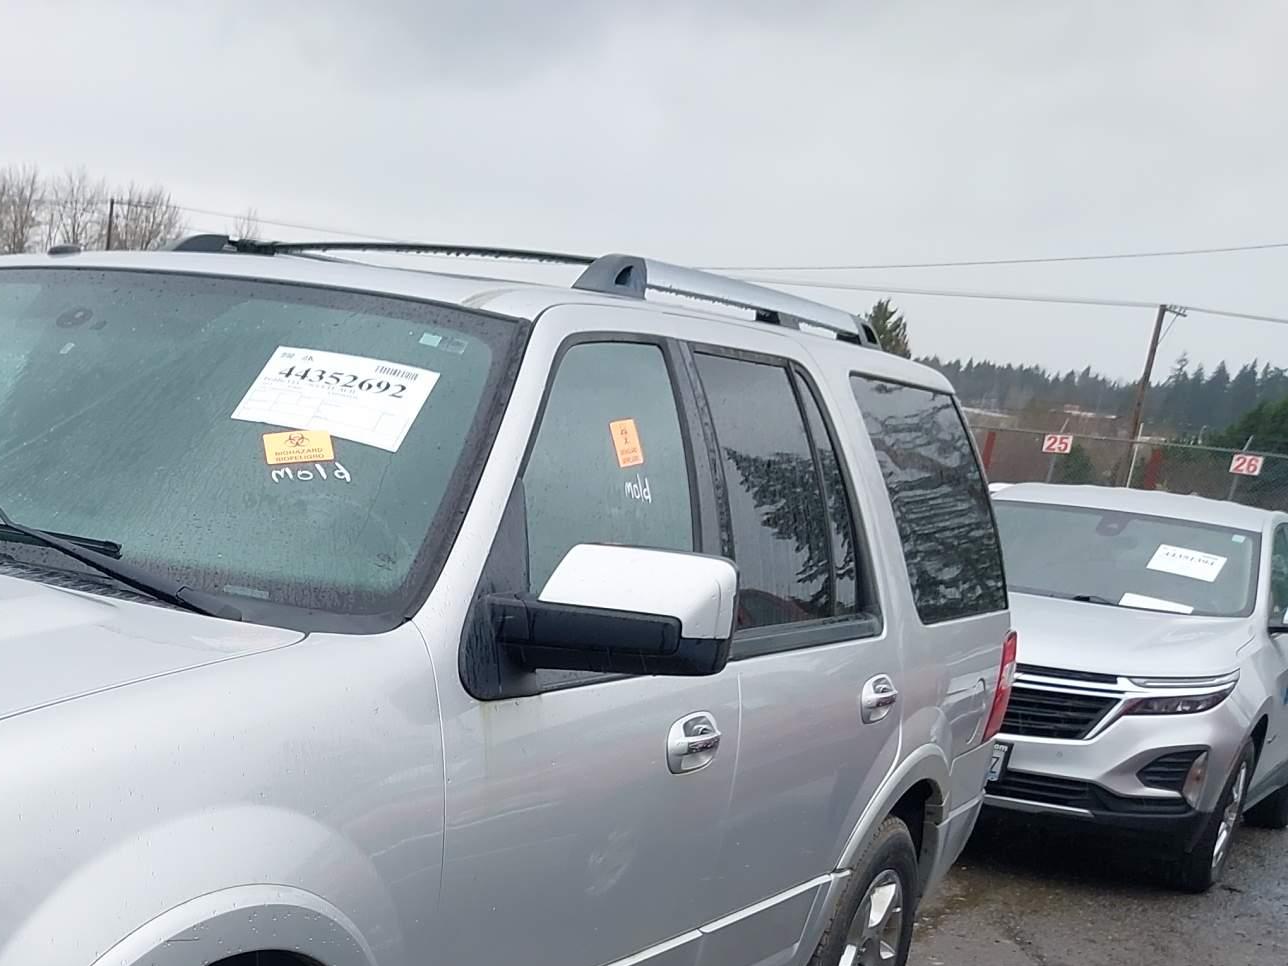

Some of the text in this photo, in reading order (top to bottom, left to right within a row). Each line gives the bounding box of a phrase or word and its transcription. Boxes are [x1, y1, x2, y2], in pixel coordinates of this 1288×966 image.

[279, 365, 407, 399] 44352692
[1046, 435, 1069, 452] 25
[271, 461, 352, 484] mold
[1232, 455, 1258, 474] 26
[624, 472, 652, 504] mold
